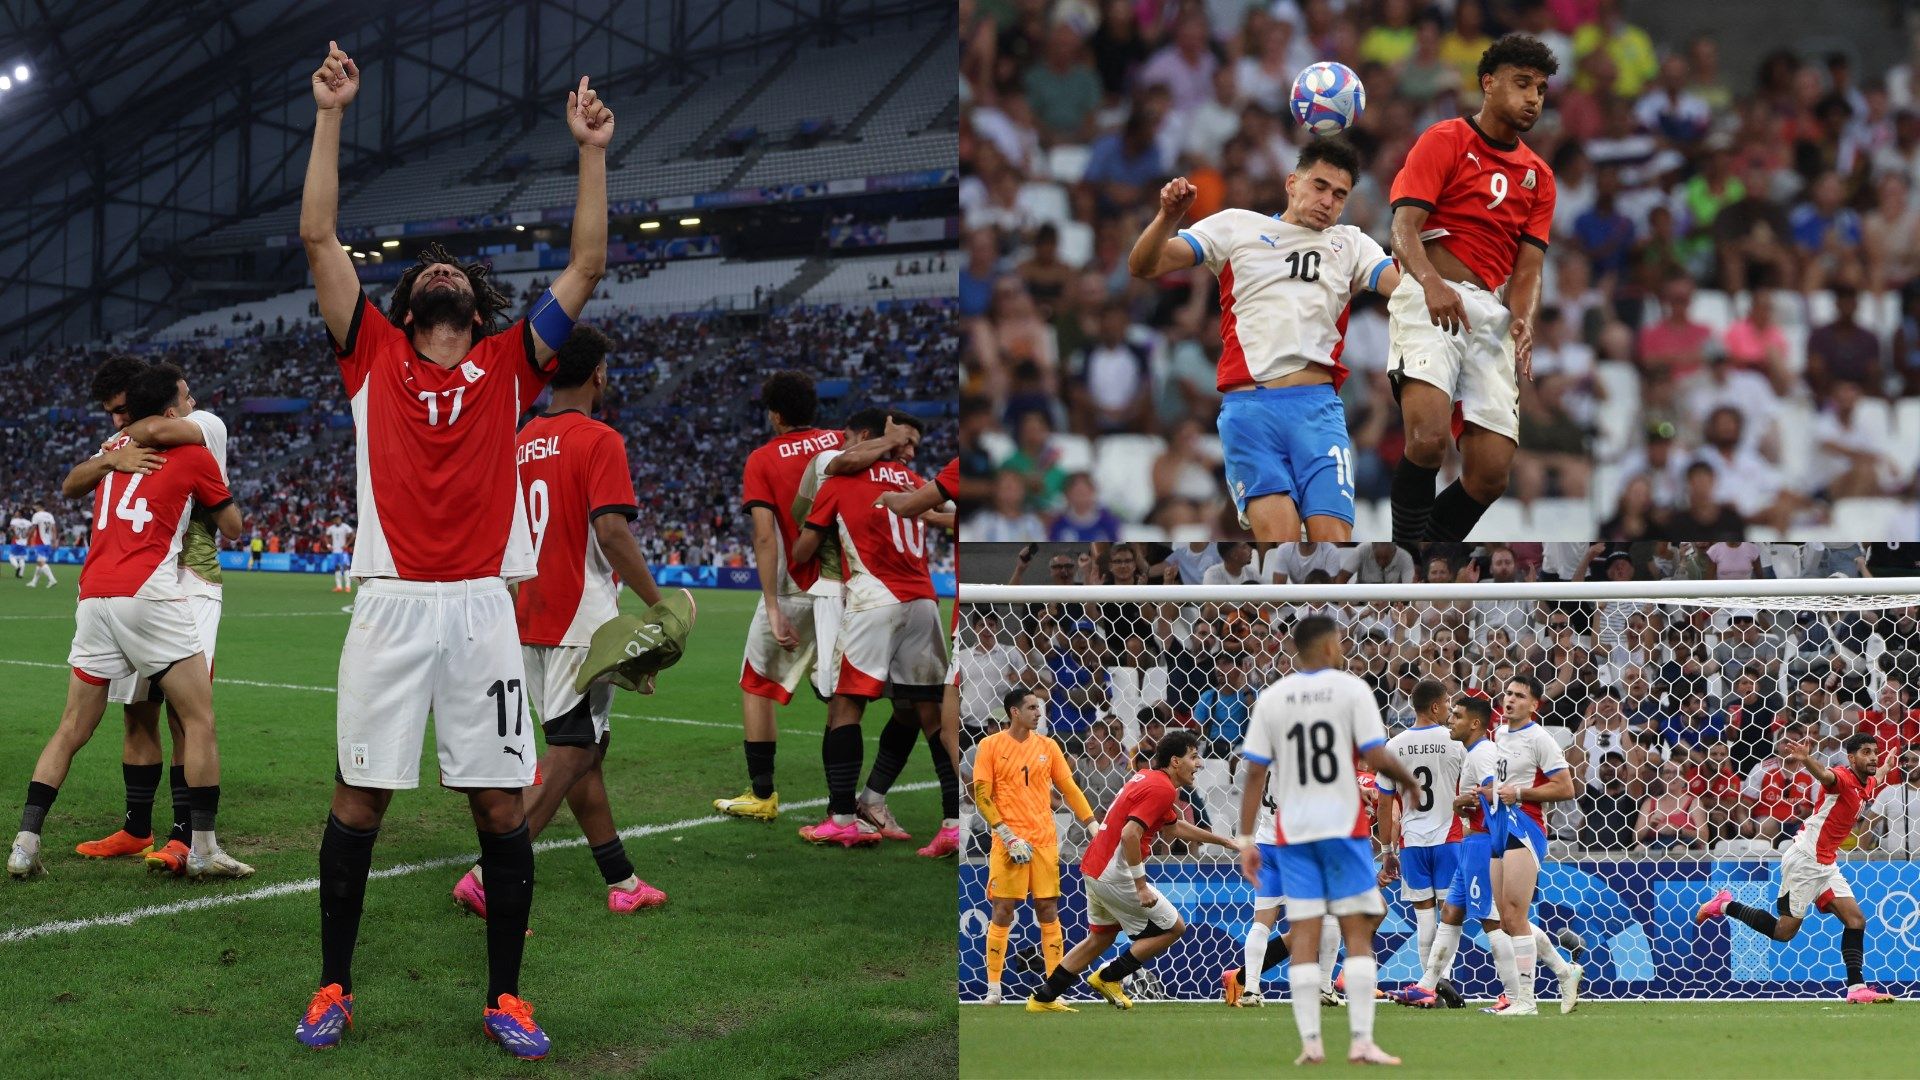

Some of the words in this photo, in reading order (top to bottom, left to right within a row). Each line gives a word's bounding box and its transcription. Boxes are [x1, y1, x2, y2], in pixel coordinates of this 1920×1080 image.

[1487, 172, 1508, 210] 9
[1285, 251, 1321, 282] 10
[418, 386, 465, 426] 17
[779, 432, 839, 458] O.FAYED
[1328, 445, 1354, 488] 10
[97, 468, 153, 533] 14
[487, 679, 523, 737] 17
[1287, 720, 1338, 786] 18
[1021, 765, 1029, 787] 1
[1413, 766, 1435, 812] 3
[1469, 875, 1481, 899] 6
